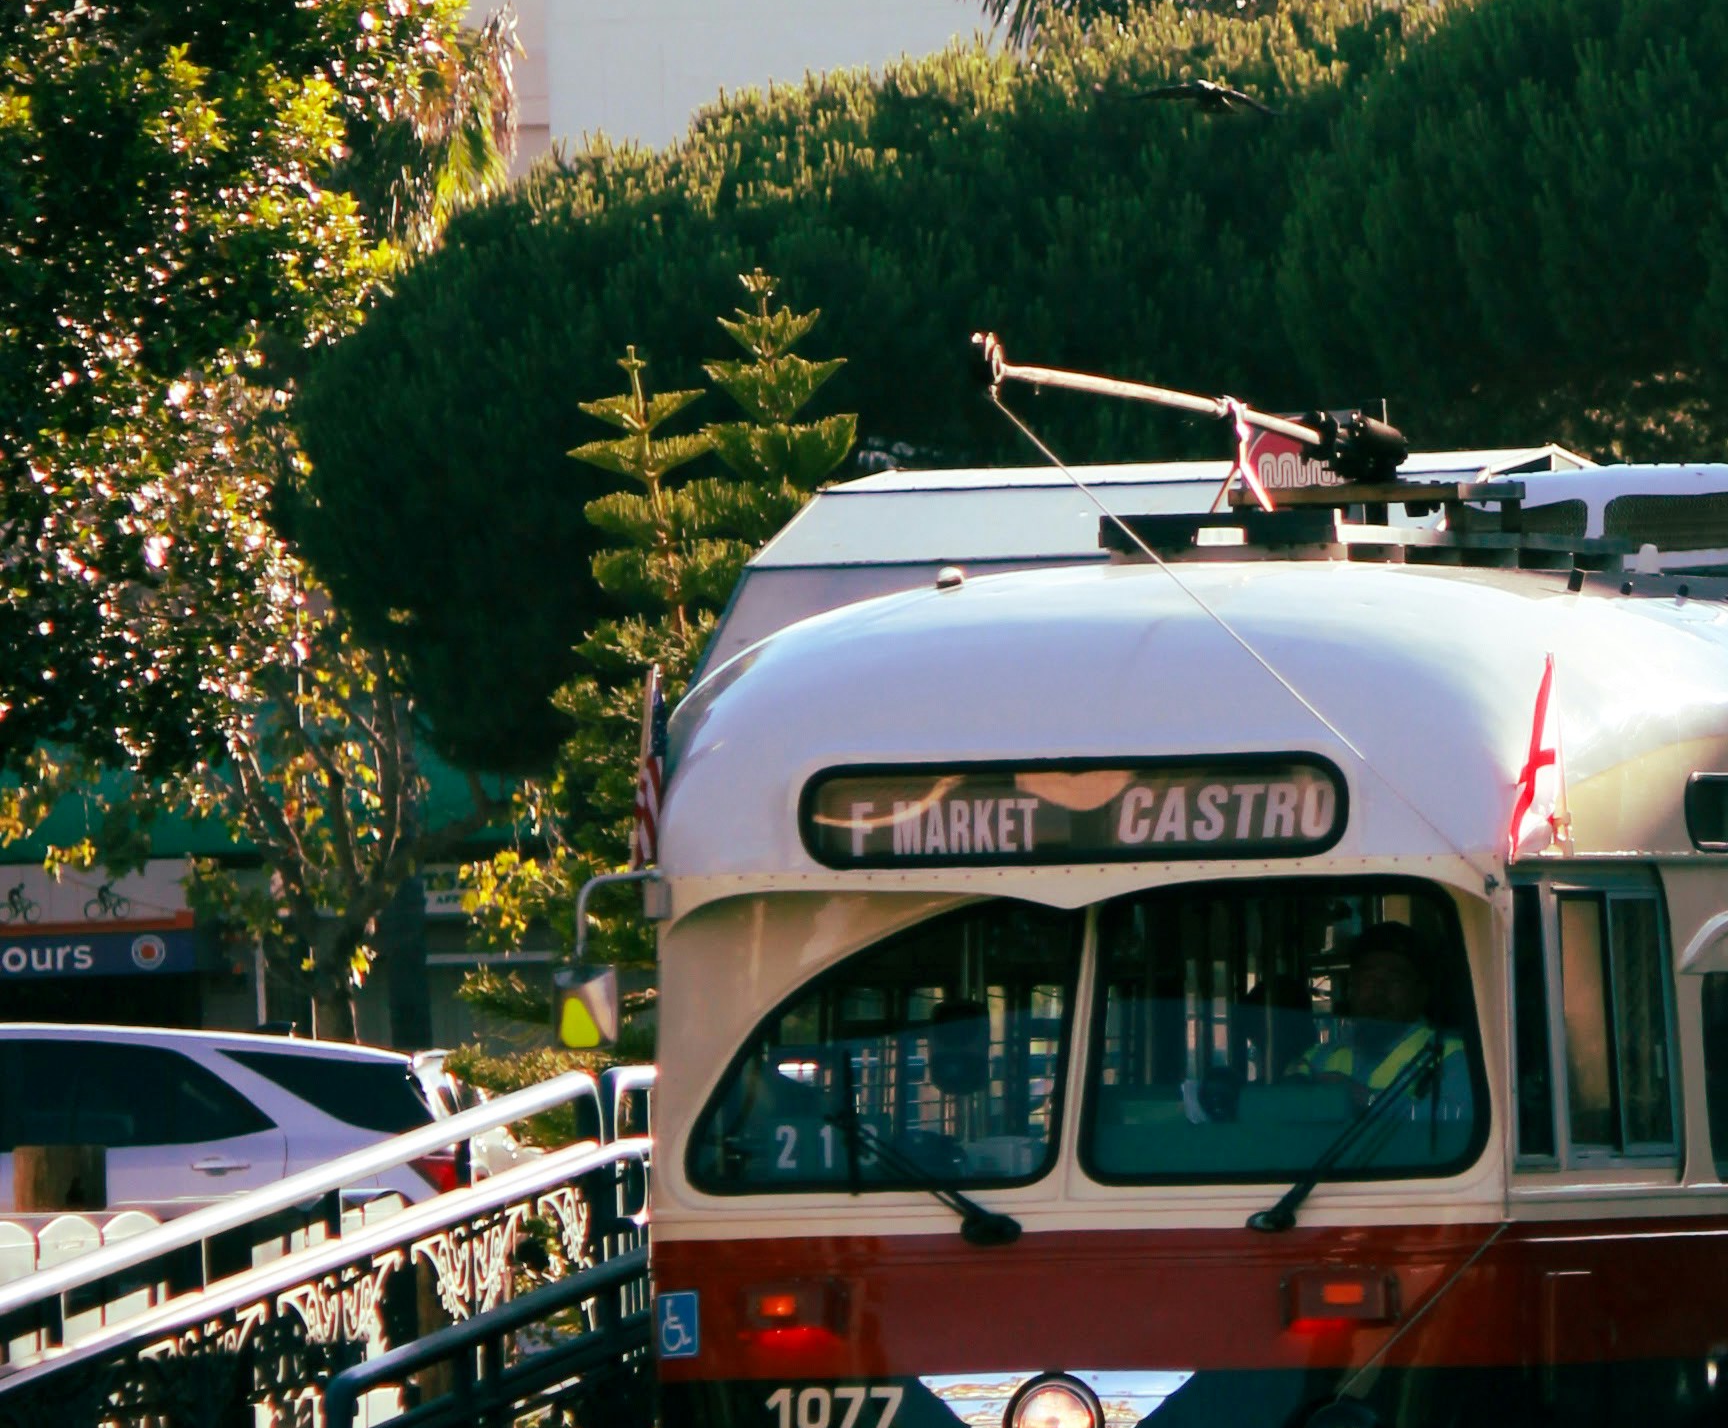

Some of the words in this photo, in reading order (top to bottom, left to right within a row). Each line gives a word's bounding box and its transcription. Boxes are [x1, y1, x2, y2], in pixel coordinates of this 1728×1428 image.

[850, 801, 875, 857] F
[892, 798, 1039, 855] MARKET
[2, 944, 94, 973] ours
